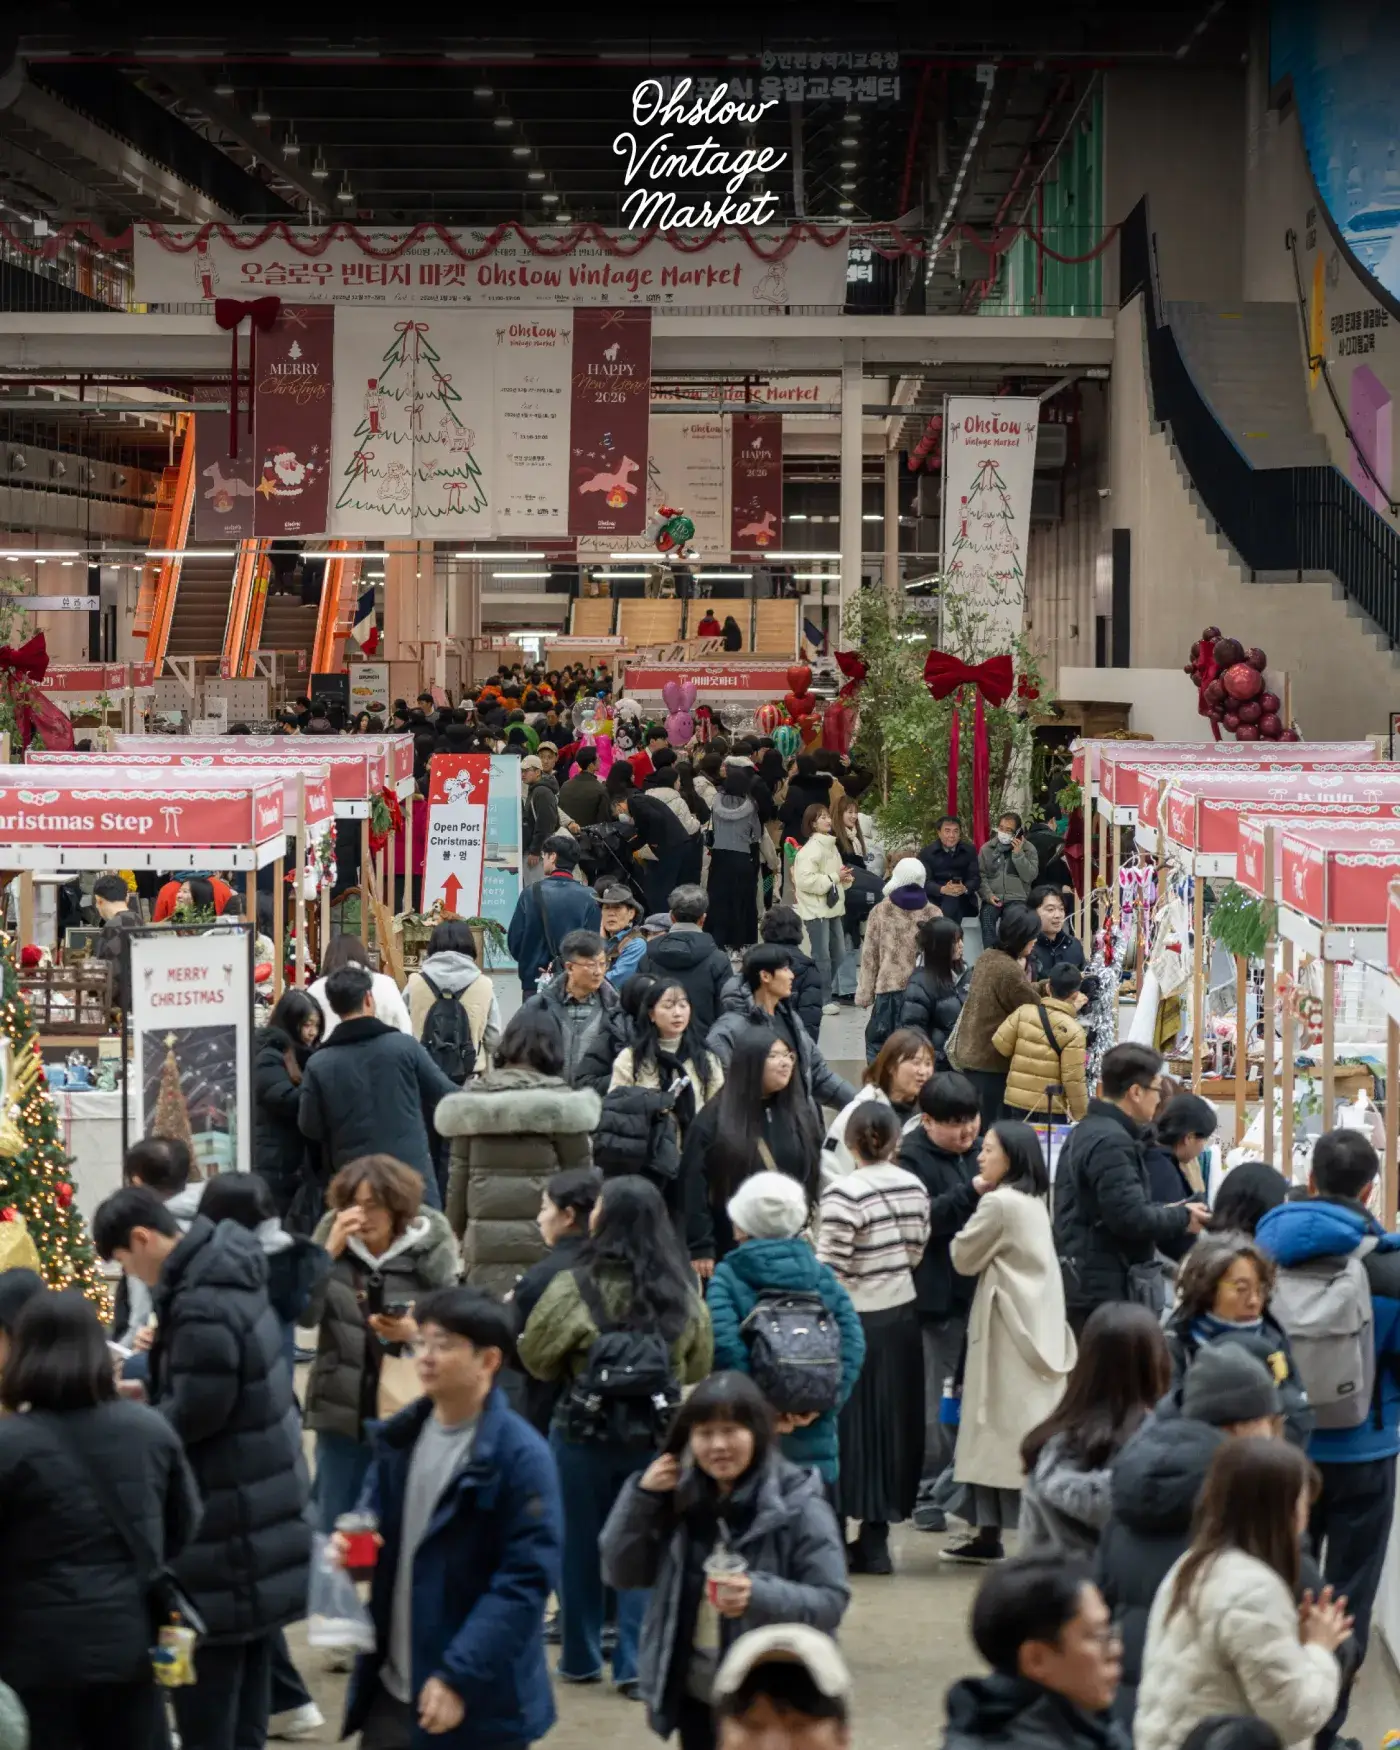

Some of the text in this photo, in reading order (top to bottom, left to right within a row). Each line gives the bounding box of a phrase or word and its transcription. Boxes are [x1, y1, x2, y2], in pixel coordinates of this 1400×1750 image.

[240, 261, 742, 292] 오슬로우 빈티지 마켓 Ohslow Vintage Market
[509, 324, 556, 338] Ohslow
[270, 363, 320, 375] MERRY
[588, 363, 636, 376] HAPPY
[258, 374, 328, 405] Christmas
[767, 385, 819, 401] Market
[594, 392, 626, 403] 2026
[964, 415, 1022, 435] Ohslow
[965, 437, 1020, 449] Vintage Market
[741, 450, 773, 459] HAPPY
[0, 811, 154, 835] ristmas Step
[434, 822, 480, 833] Open Port
[430, 836, 481, 847] Christmas:
[483, 876, 504, 885] ffee
[167, 966, 208, 981] MERRY
[150, 989, 224, 1007] CHRISTMAS
